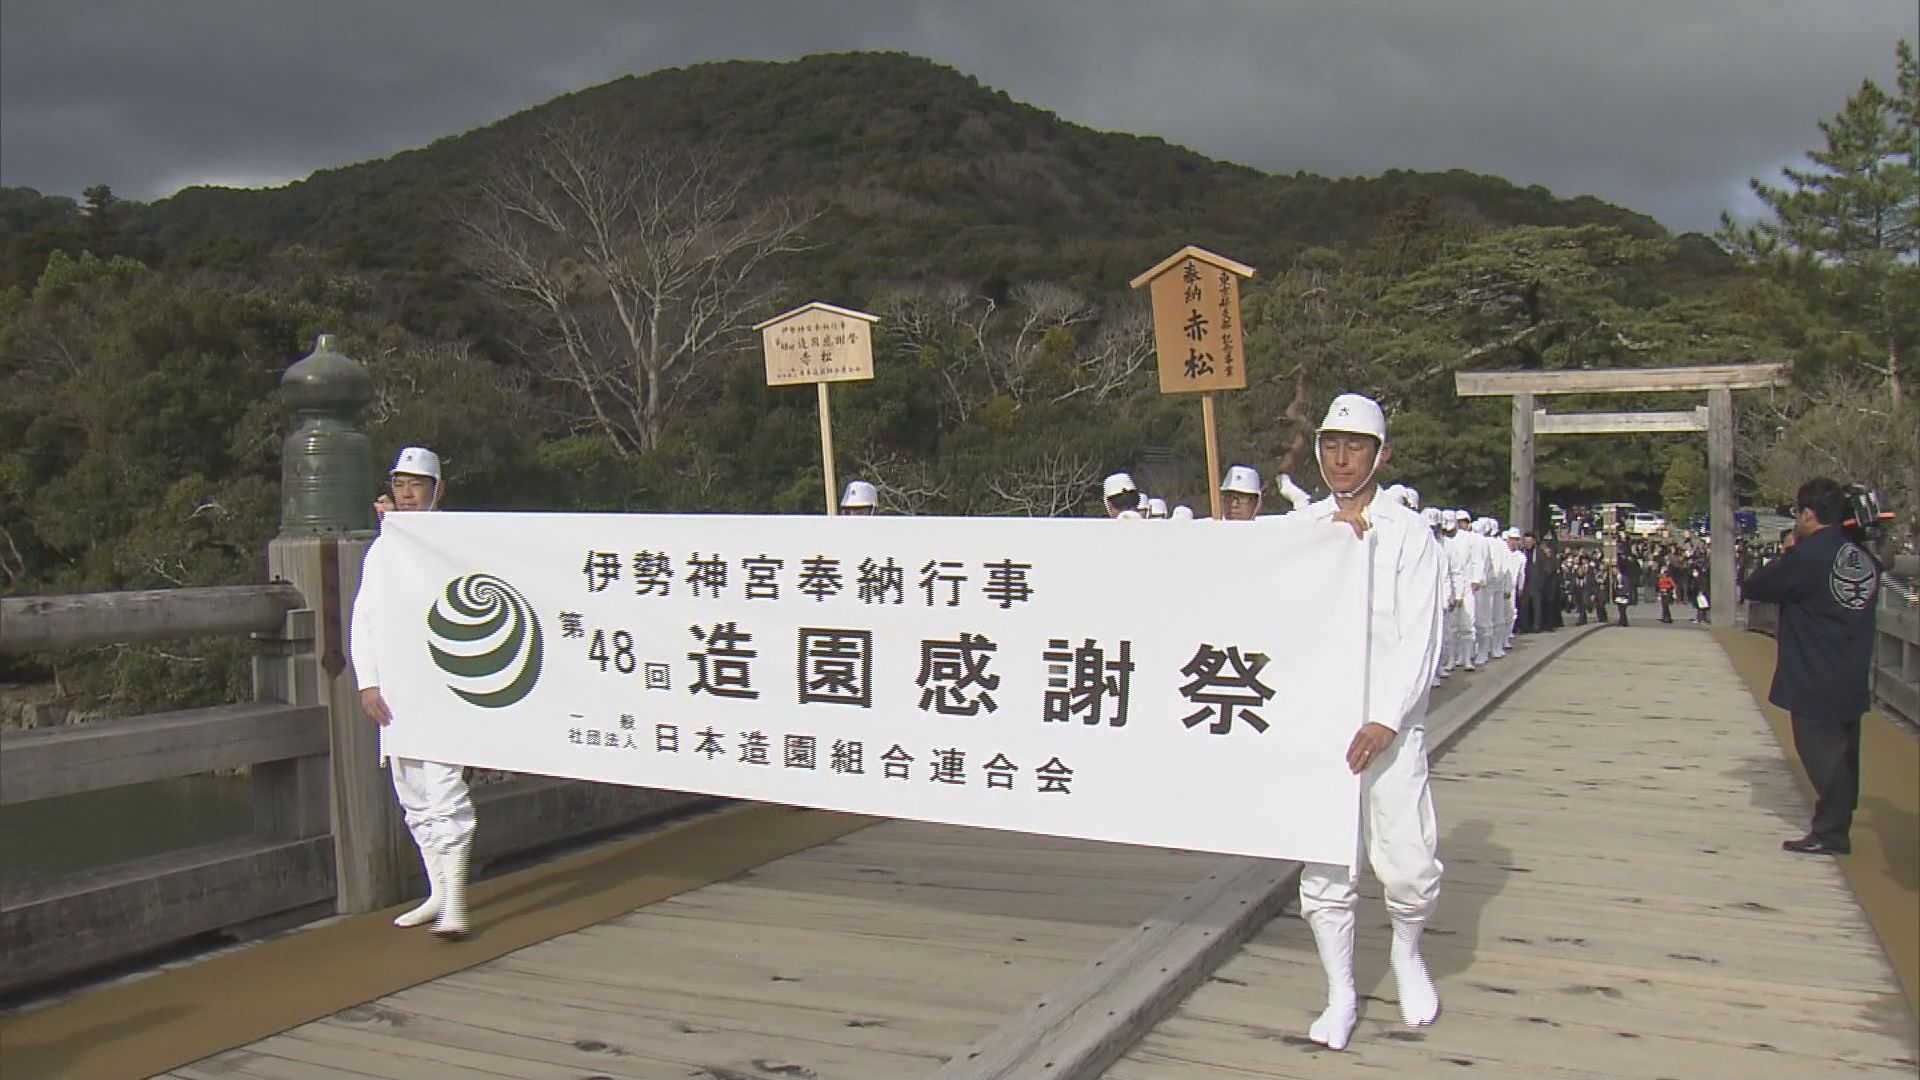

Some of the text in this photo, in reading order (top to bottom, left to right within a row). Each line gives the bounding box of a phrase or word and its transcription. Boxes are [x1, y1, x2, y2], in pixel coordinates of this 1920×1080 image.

[1183, 260, 1215, 379] 奉納 赤松
[582, 549, 1034, 609] 伊勢神宮奉納行事
[558, 610, 1277, 735] 第48回 造園感謝祭
[568, 723, 1074, 795] 社団法人 日本造園組合連合会
